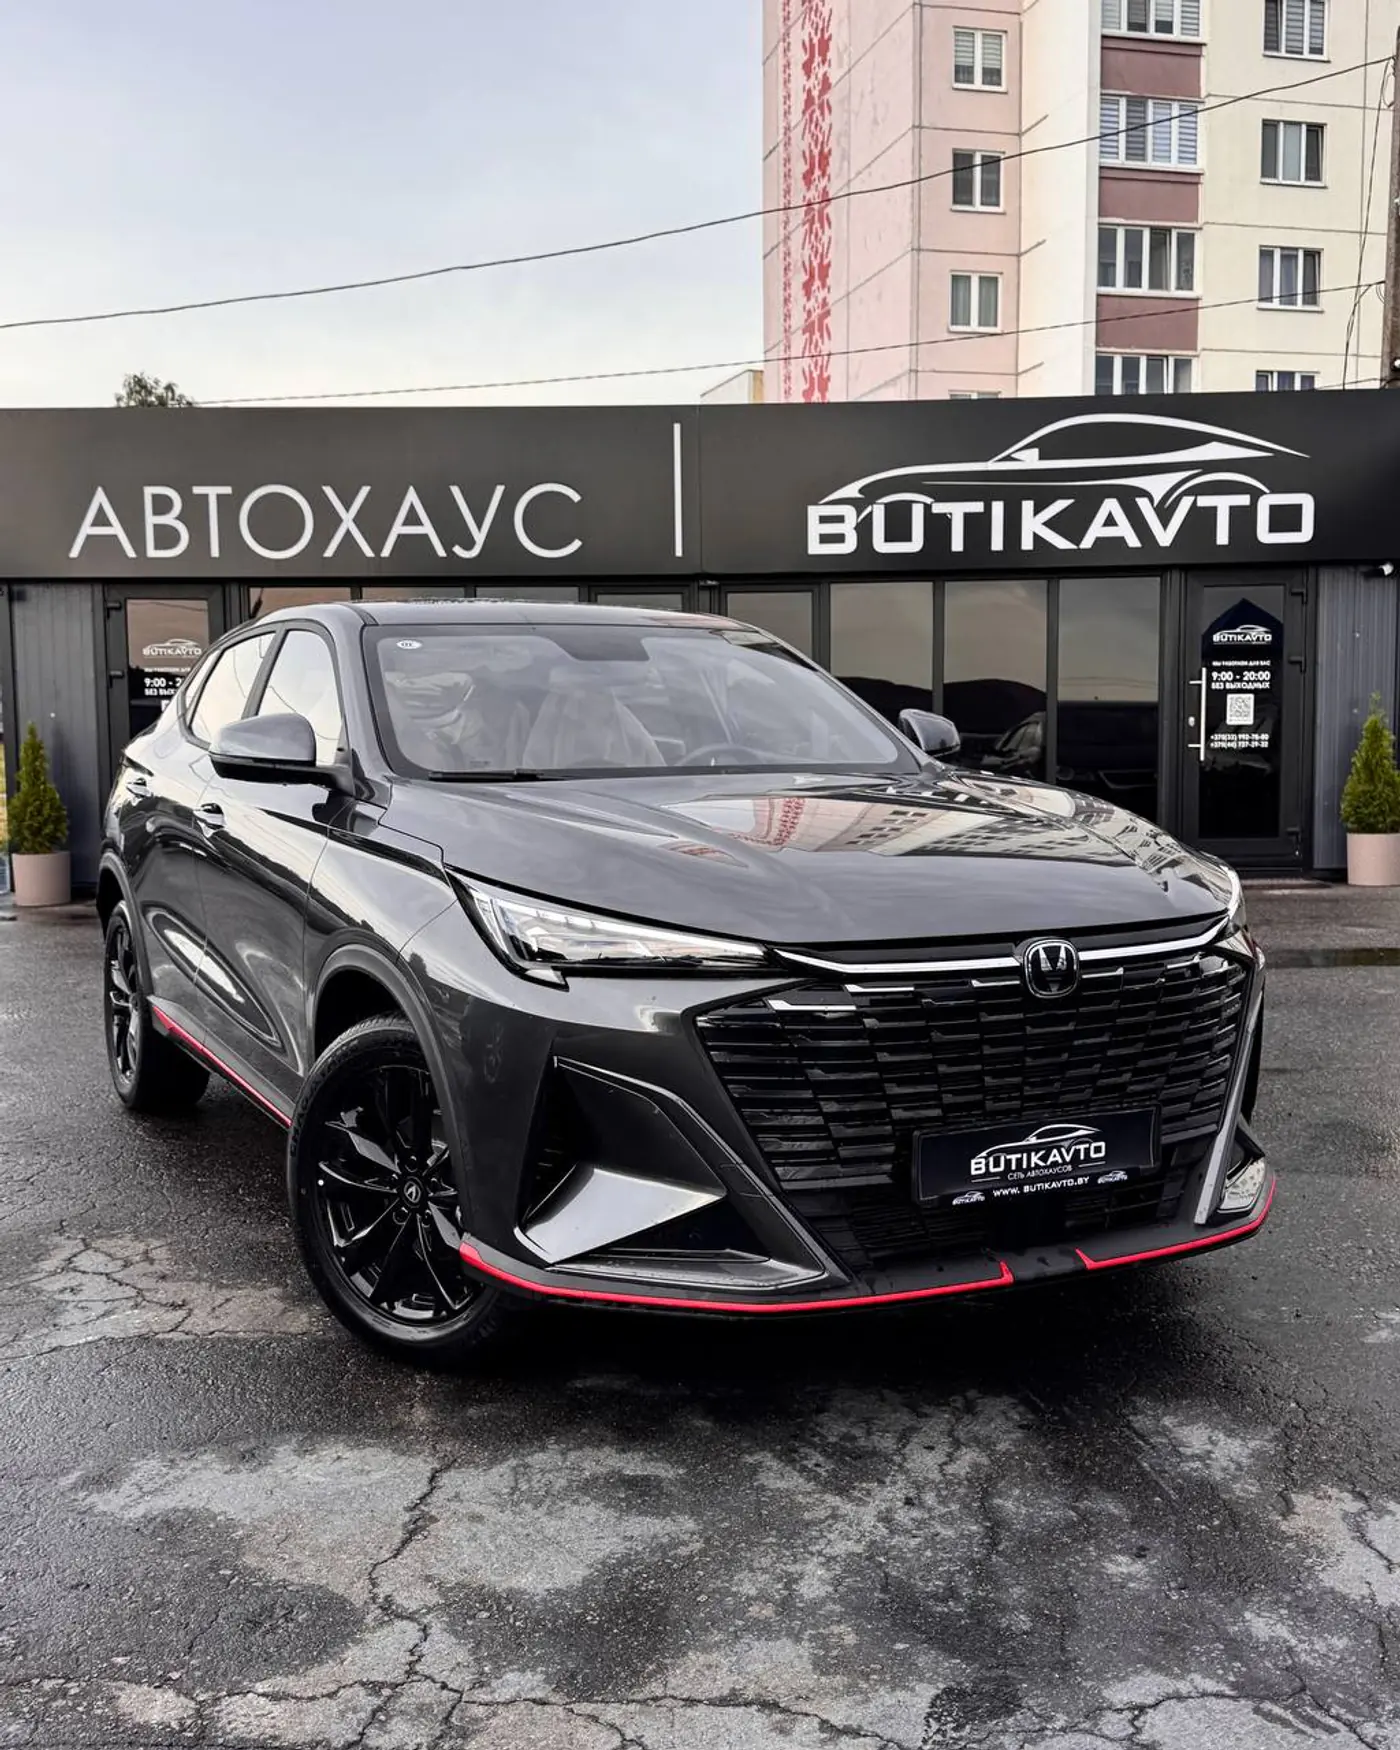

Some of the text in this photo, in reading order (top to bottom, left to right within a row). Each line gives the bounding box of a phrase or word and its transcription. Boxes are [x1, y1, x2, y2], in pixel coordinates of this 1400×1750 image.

[69, 483, 583, 559] АВТОХАУС
[806, 492, 1315, 556] BUTIKAVTO
[1212, 633, 1272, 642] BUTIKAVTO
[144, 677, 167, 687] 9:00
[1211, 671, 1233, 681] 9:00
[1242, 671, 1270, 681] 20:00
[970, 1141, 1106, 1175] BUTIKAVTO
